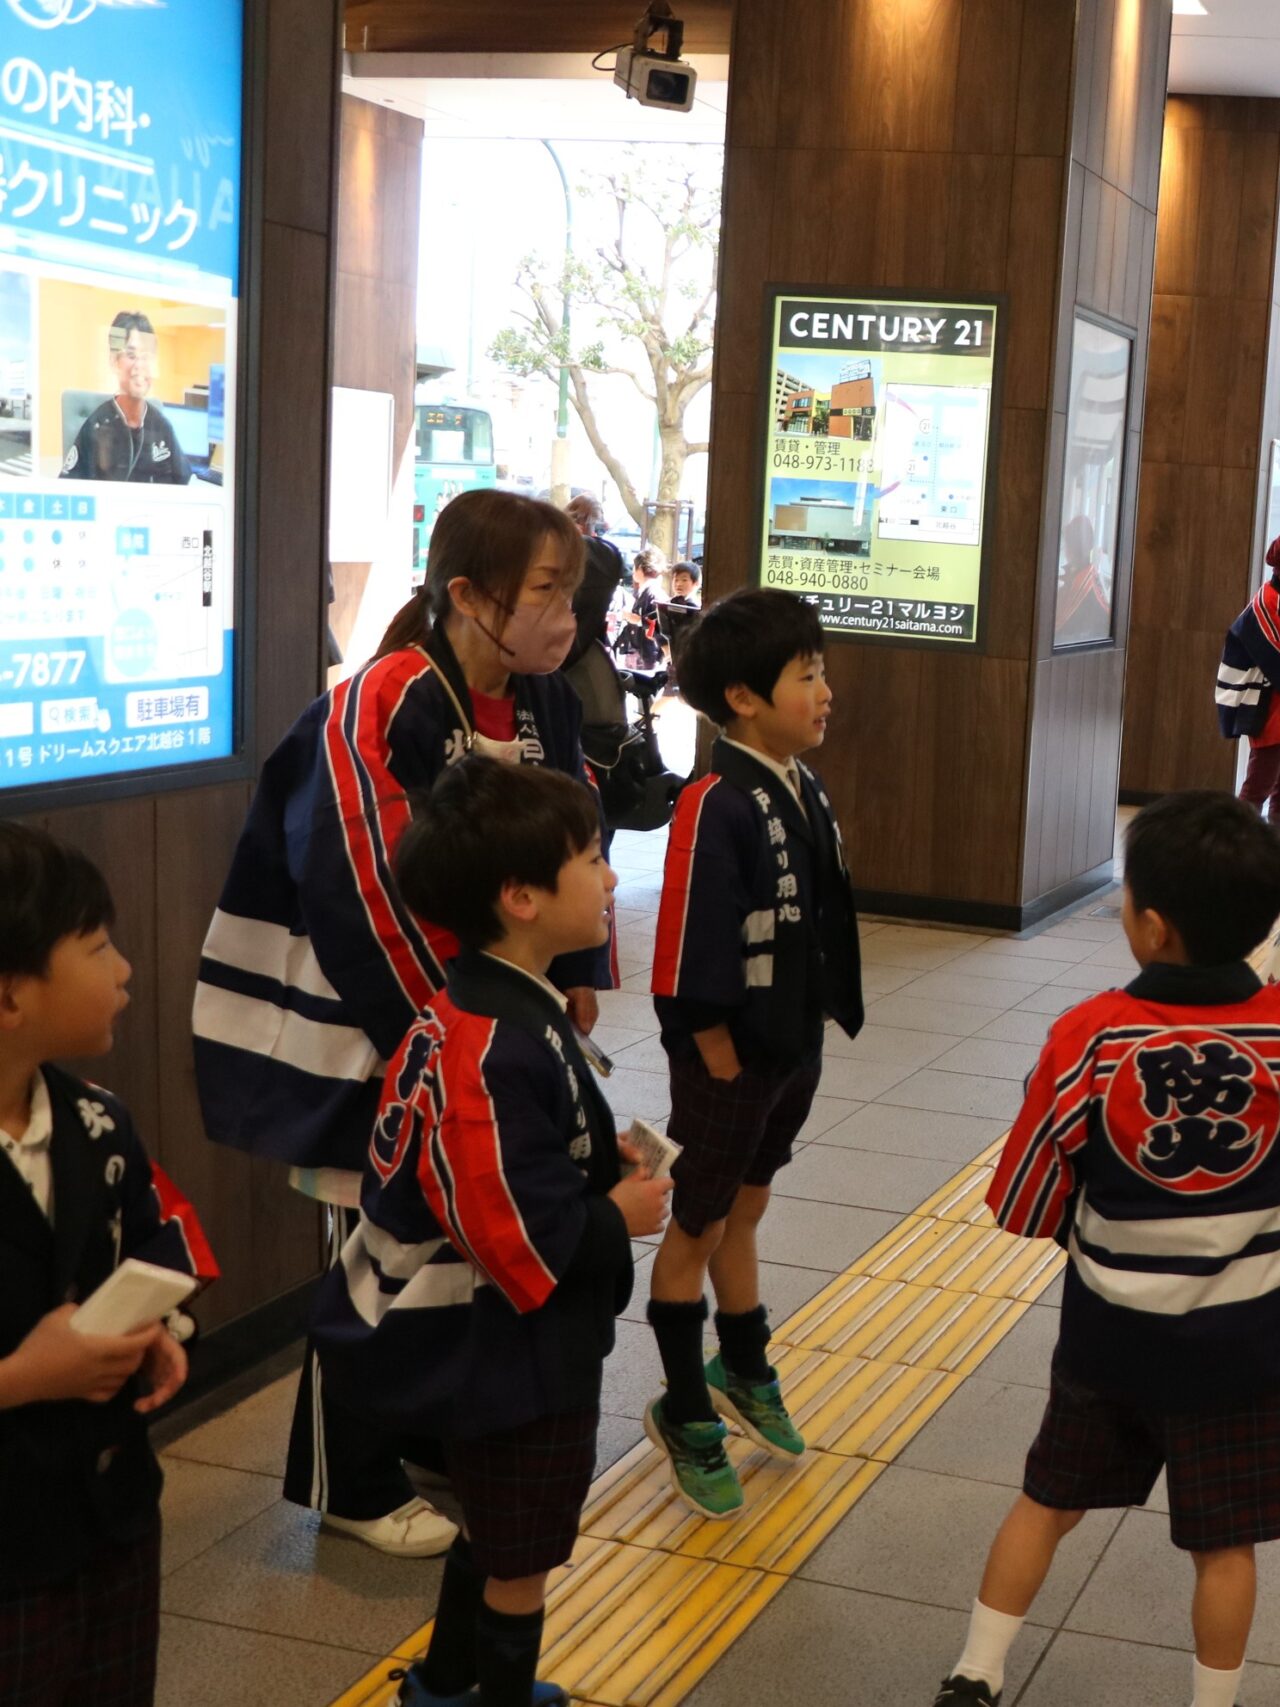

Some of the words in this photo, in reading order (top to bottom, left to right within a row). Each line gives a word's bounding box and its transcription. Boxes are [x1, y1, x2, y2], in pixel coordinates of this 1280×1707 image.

[789, 312, 947, 345] CENTURY
[954, 318, 983, 346] 21
[774, 439, 841, 456] 賃貸・管理
[767, 569, 869, 591] 048-940-0880
[799, 594, 965, 621] チュリー21マルヨシ
[819, 612, 963, 635] ww.century21saitama.com
[0, 650, 86, 688] -7877
[137, 694, 200, 722] 駐車場有
[752, 787, 801, 922] 戸締り用心
